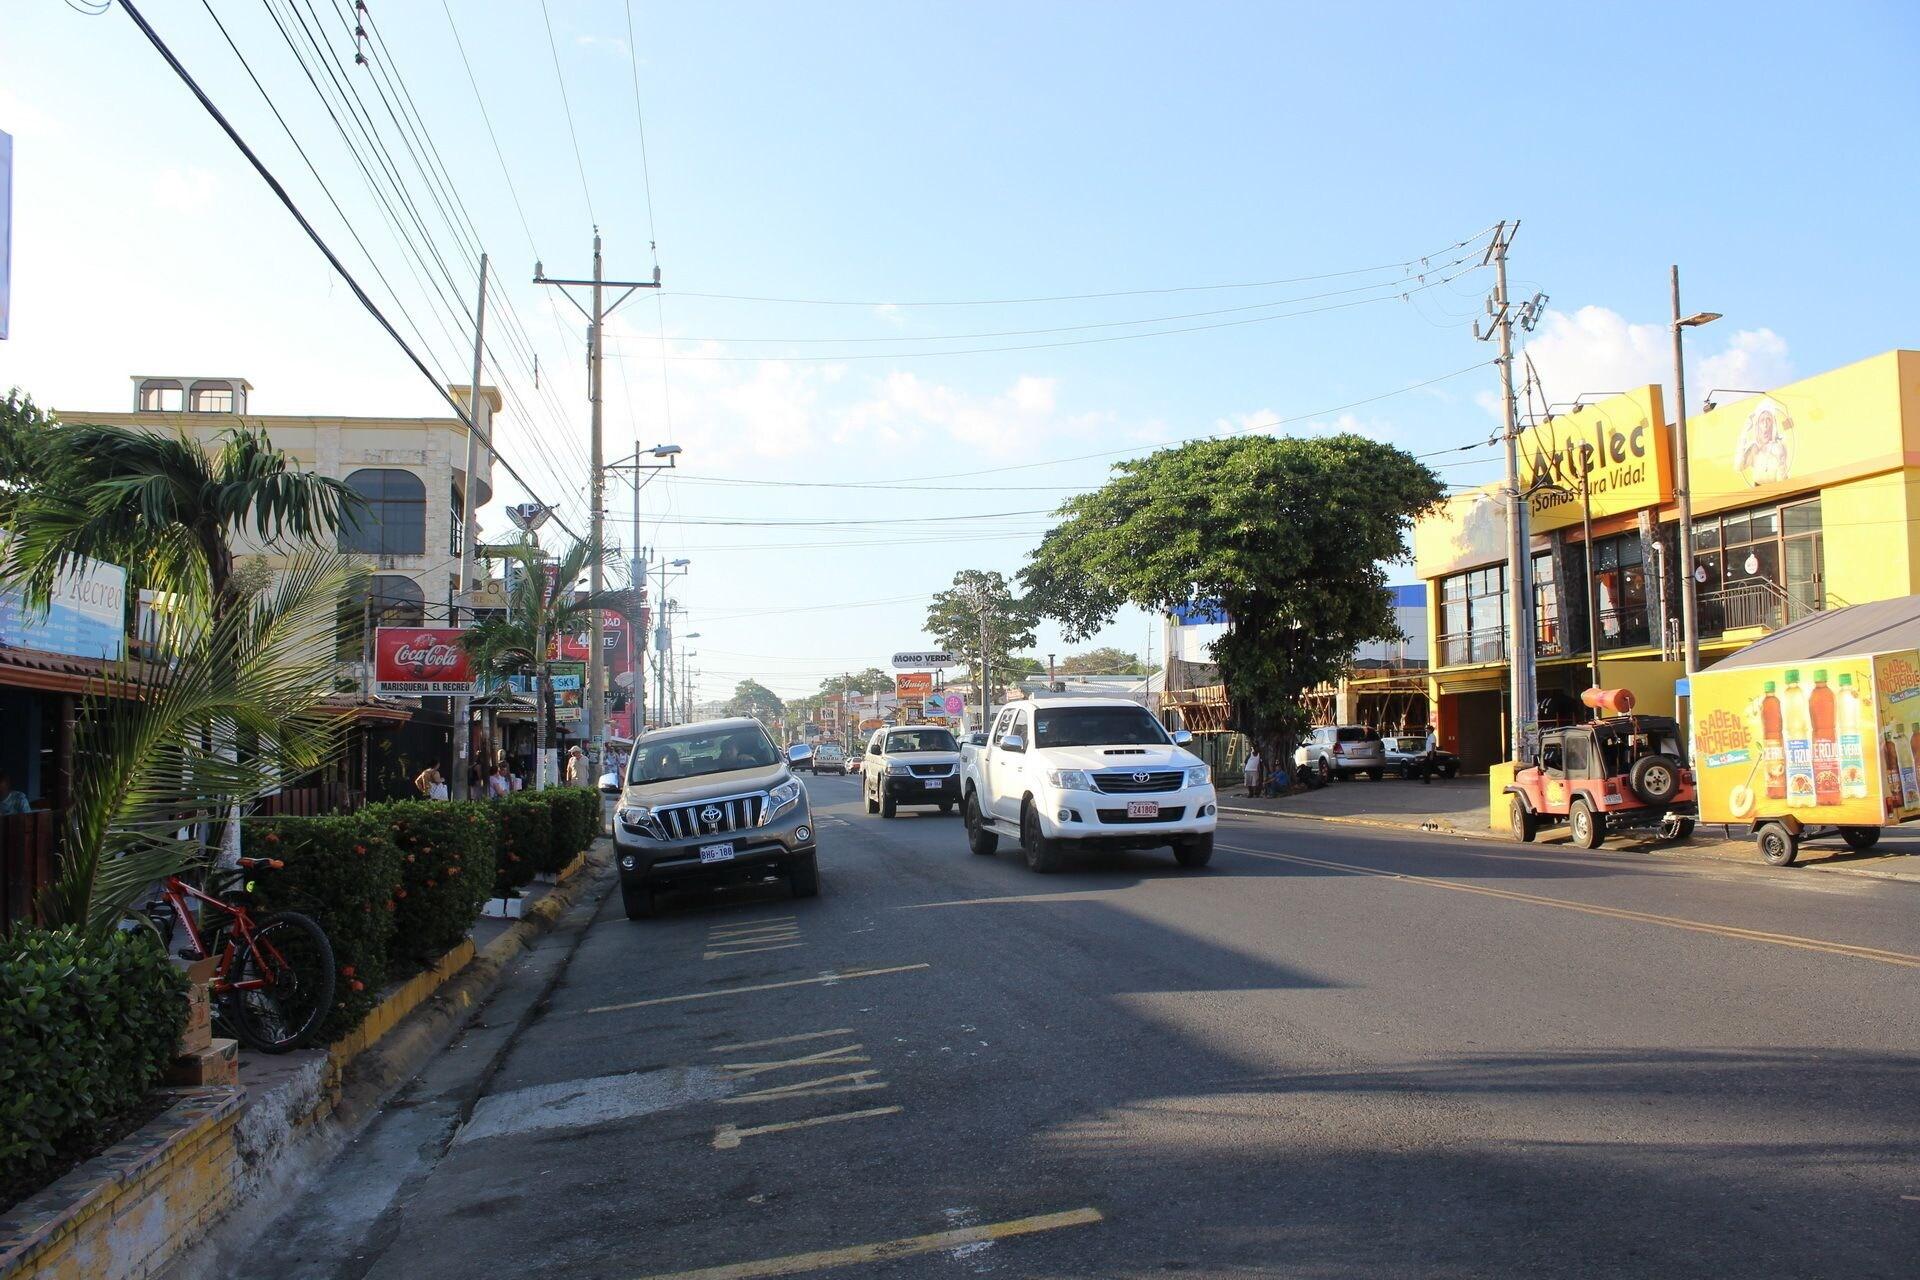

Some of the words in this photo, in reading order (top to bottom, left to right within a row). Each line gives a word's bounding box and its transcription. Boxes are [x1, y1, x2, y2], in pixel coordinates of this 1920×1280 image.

[1530, 420, 1645, 489] Artelec
[1609, 462, 1645, 490] Vida!
[394, 644, 458, 666] Coca-Cola
[894, 655, 922, 663] MONO
[924, 654, 952, 662] VERDE
[1882, 658, 1912, 680] SABEN
[432, 683, 441, 691] EL
[558, 678, 575, 687] SKY
[1699, 709, 1742, 737] SABEN
[1133, 805, 1157, 814] 241809
